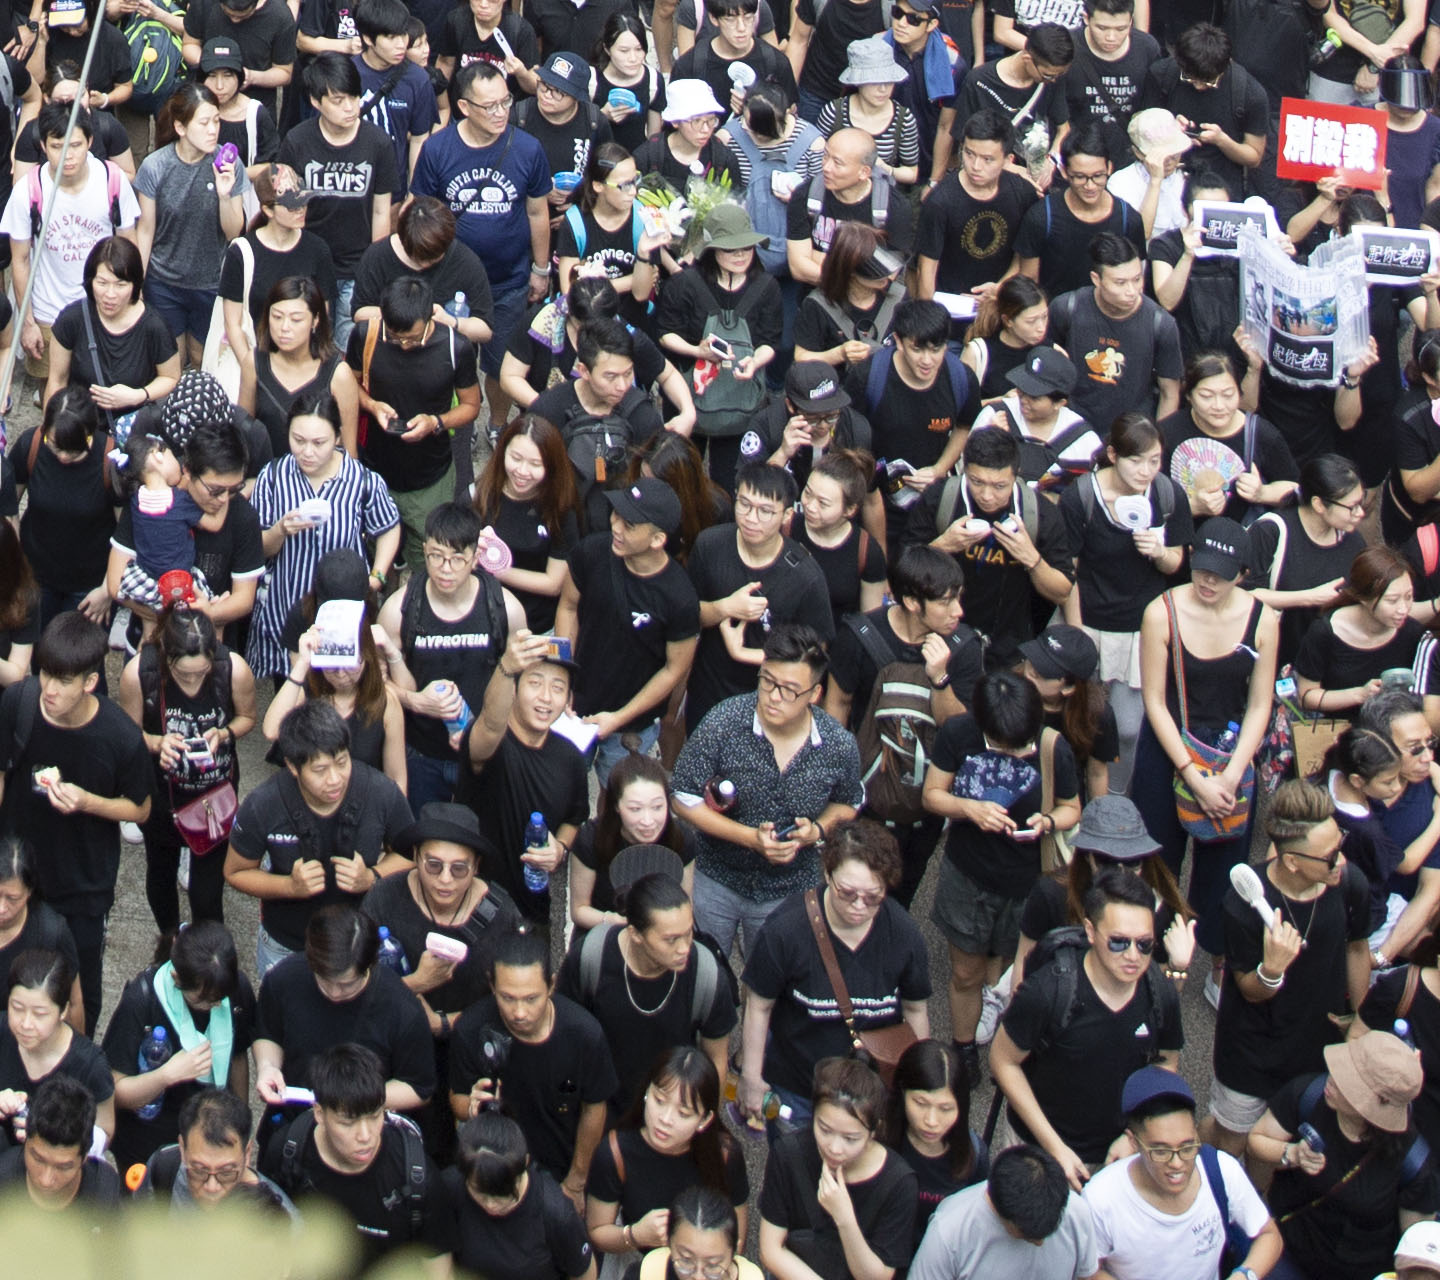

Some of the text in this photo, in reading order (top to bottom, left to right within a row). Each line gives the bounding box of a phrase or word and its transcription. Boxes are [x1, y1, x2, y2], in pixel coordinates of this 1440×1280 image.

[1283, 114, 1378, 173] 別殺我
[325, 161, 354, 173] 1873
[312, 171, 366, 191] LEVI'S
[446, 169, 473, 200] SOUTH
[61, 214, 103, 237] STRAUSS
[415, 633, 489, 649] MYPROTEIN
